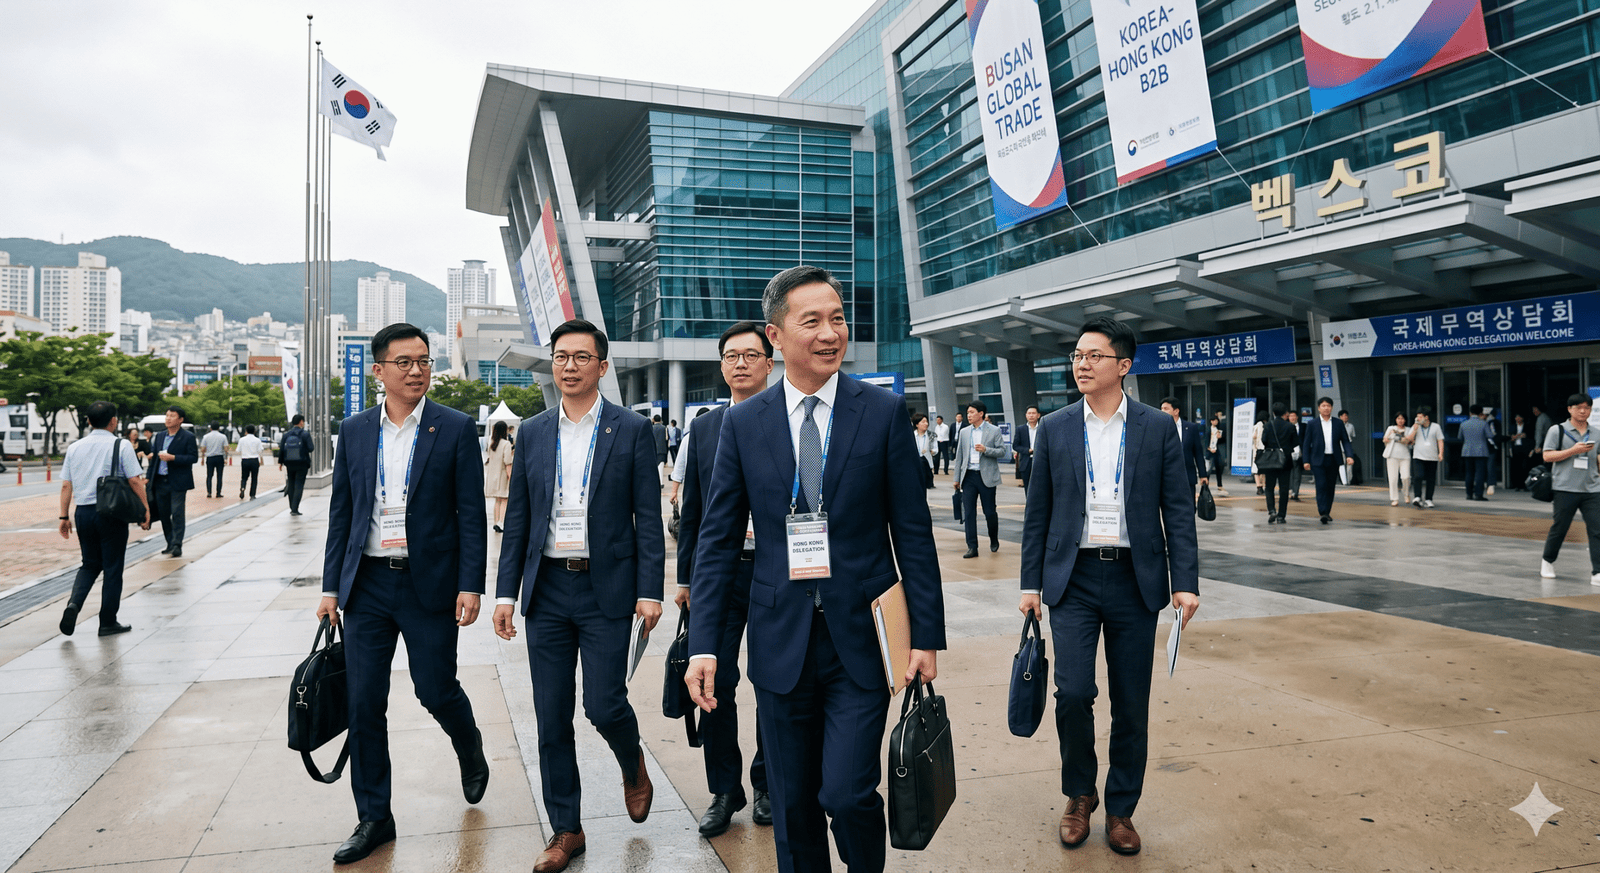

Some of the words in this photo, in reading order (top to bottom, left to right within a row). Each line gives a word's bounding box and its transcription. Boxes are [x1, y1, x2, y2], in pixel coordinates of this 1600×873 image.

[1119, 5, 1174, 48] KOREA-
[1314, 0, 1341, 12] SEO
[985, 38, 1033, 87] BUSAN
[1108, 44, 1148, 82] HONG
[1151, 19, 1194, 59] KONG
[986, 67, 1042, 115] GLOBAL
[1140, 63, 1169, 93] B2B
[995, 97, 1043, 140] TRADE
[1393, 339, 1442, 352] KOREA-HONG
[1443, 336, 1467, 348] KONG
[1468, 332, 1524, 346] DELEGATION
[1524, 327, 1575, 341] WELCOME
[1189, 359, 1204, 368] KONG
[1204, 357, 1233, 367] DELEGATION
[1234, 355, 1257, 364] WELCOME
